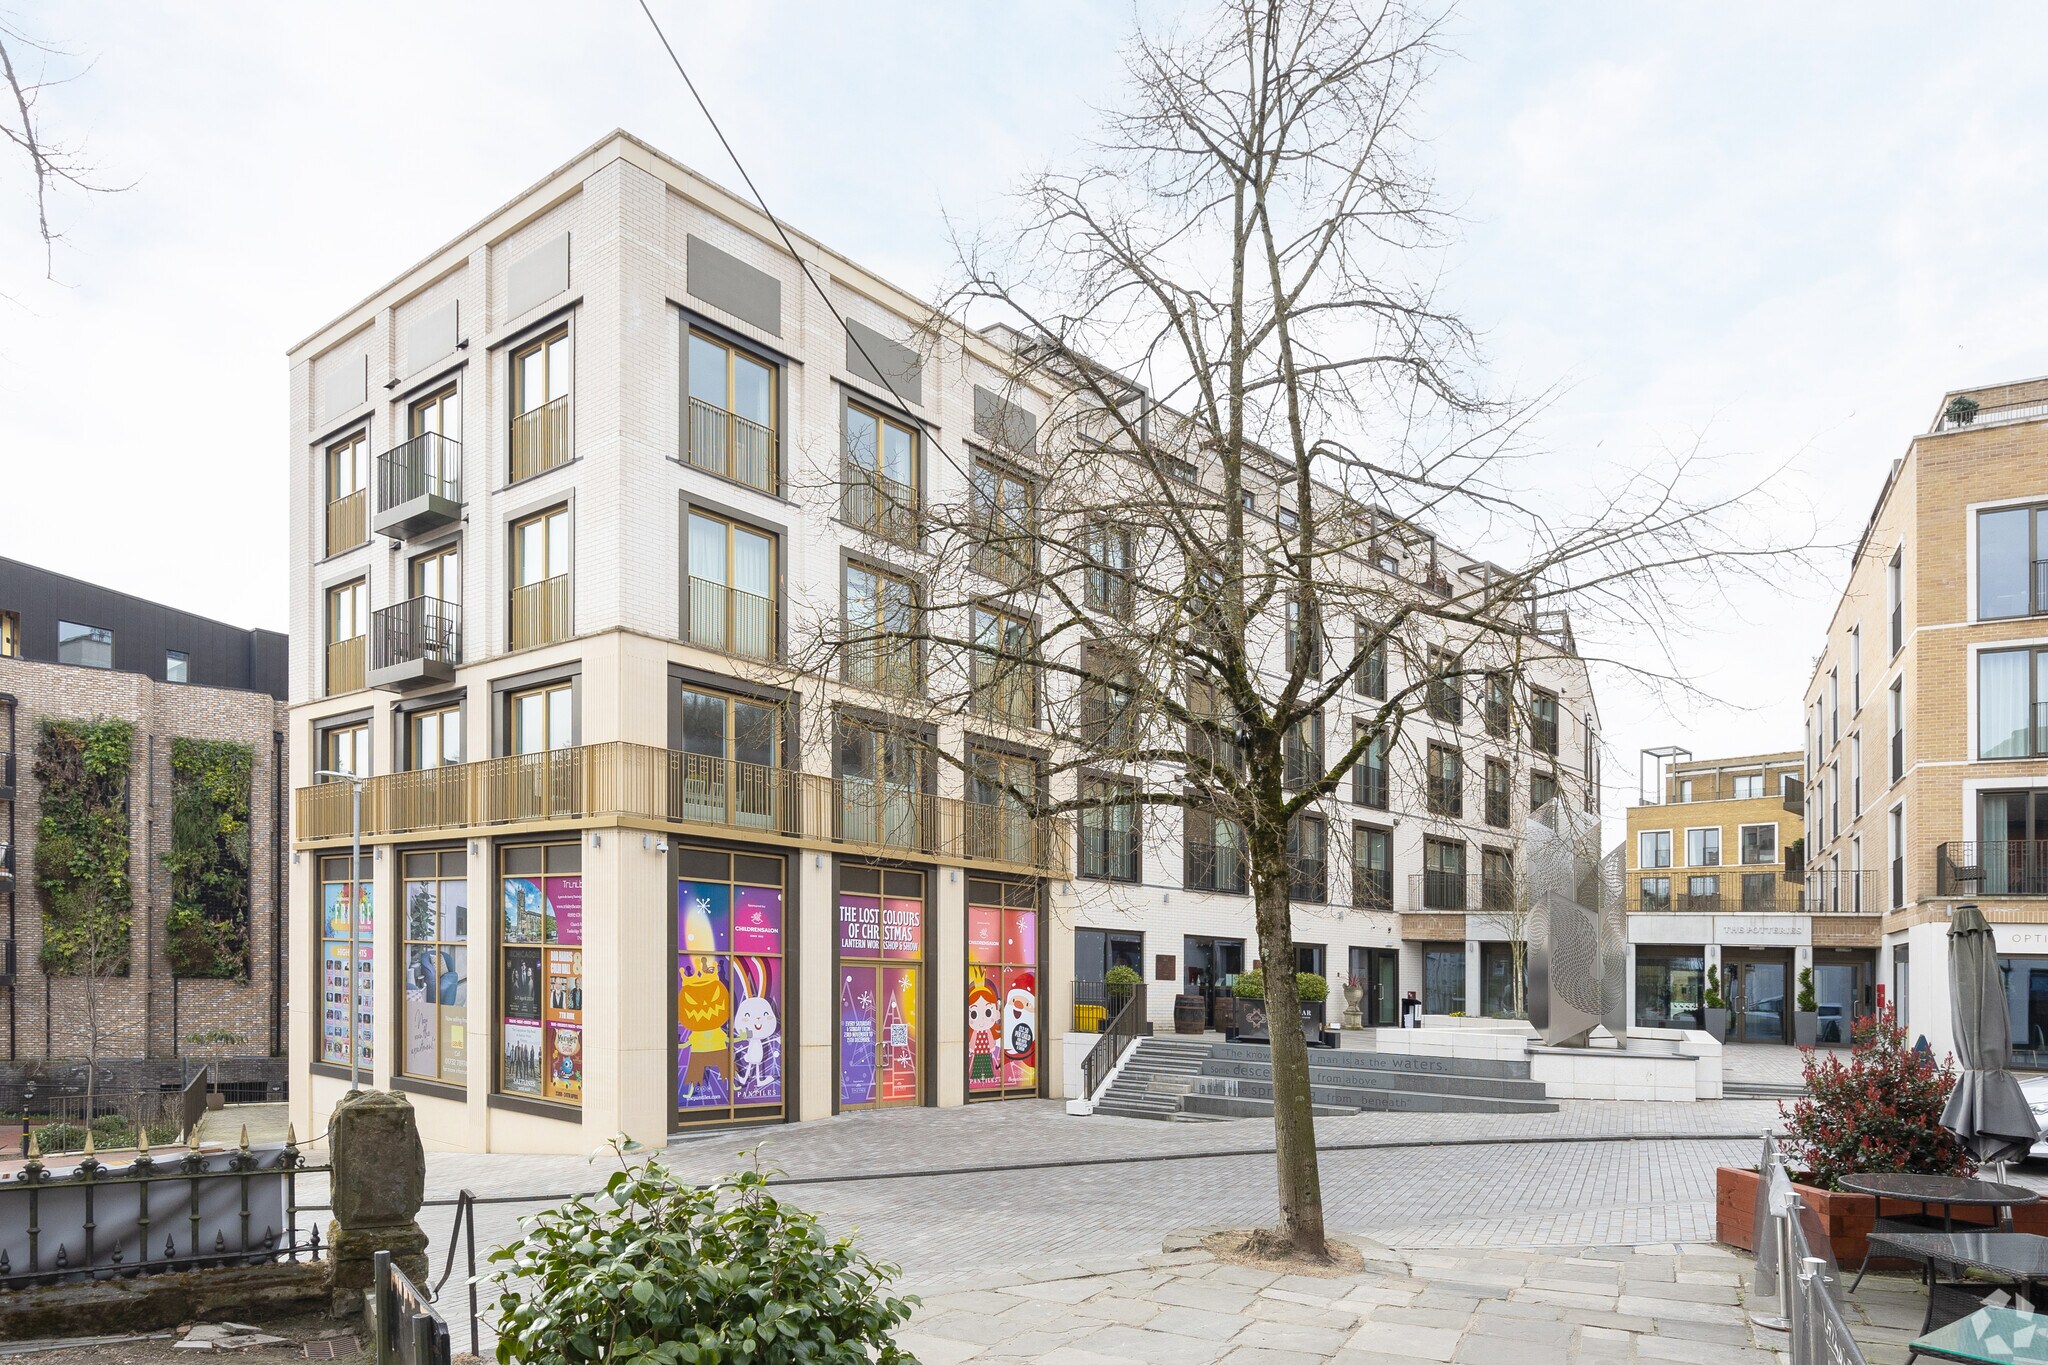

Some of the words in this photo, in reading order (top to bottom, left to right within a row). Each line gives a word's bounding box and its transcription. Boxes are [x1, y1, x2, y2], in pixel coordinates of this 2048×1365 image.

[334, 902, 372, 924] FRIGE
[840, 906, 856, 921] THE
[859, 908, 880, 924] LOST
[882, 909, 920, 926] COLOURS
[848, 923, 860, 938] OF
[862, 924, 912, 942] CHRISTMAS
[842, 938, 866, 949] LANTERN
[903, 942, 918, 951] SHOW
[1317, 1056, 1338, 1064] man
[1343, 1055, 1350, 1065] is
[1369, 1058, 1386, 1068] the
[1392, 1059, 1448, 1071] waters.
[1211, 1066, 1229, 1074] Some
[1317, 1073, 1341, 1083] from
[1345, 1075, 1377, 1086] above
[737, 1089, 776, 1098] PANTILES
[1327, 1093, 1351, 1103] from
